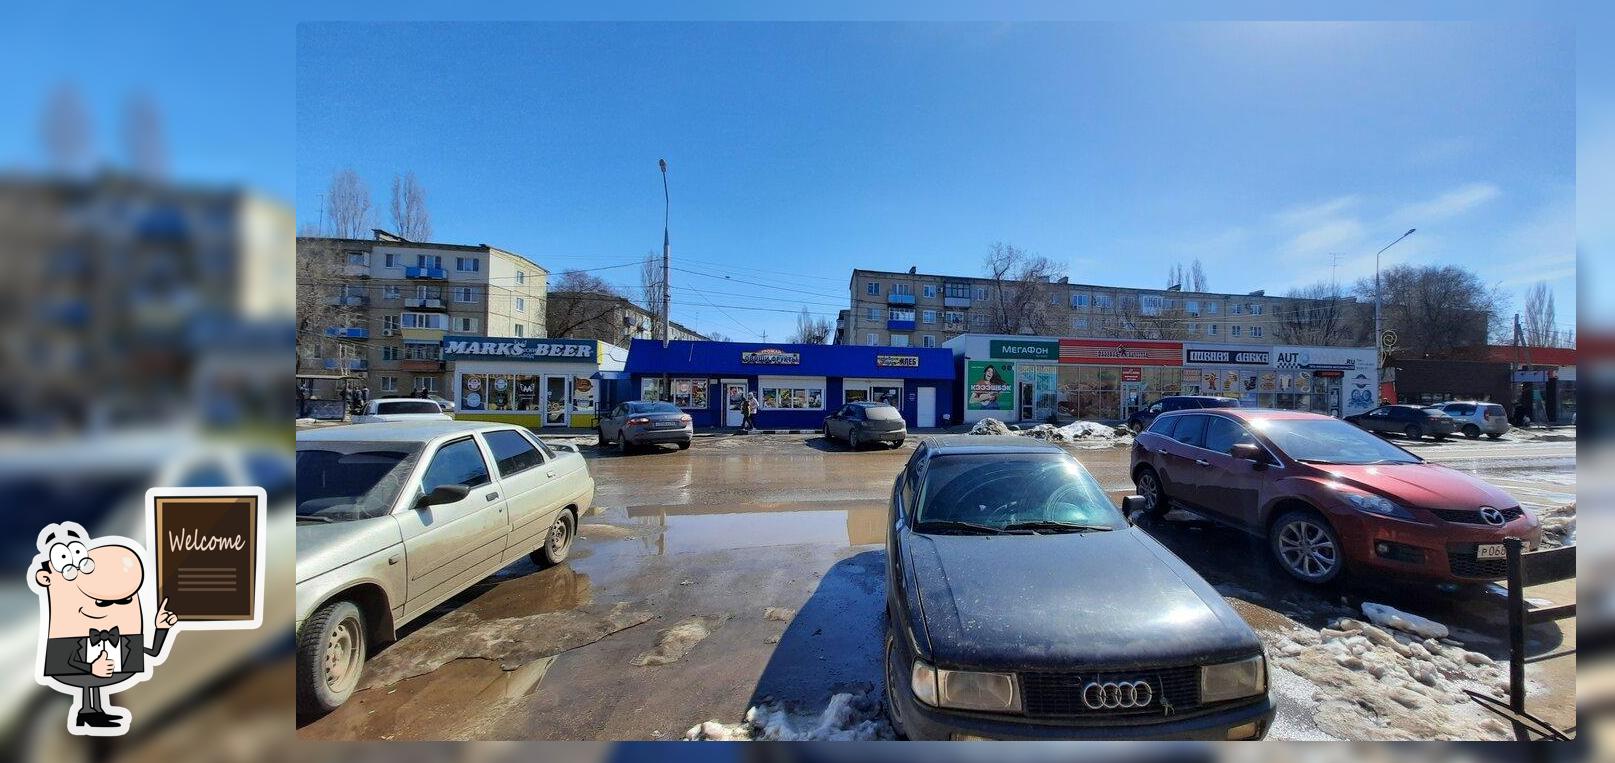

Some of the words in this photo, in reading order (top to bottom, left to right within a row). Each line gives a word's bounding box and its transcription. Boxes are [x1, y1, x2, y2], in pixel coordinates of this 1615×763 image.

[445, 341, 527, 356] MARKS
[535, 343, 593, 358] BEER
[1190, 351, 1230, 362] ПИВНАЯ
